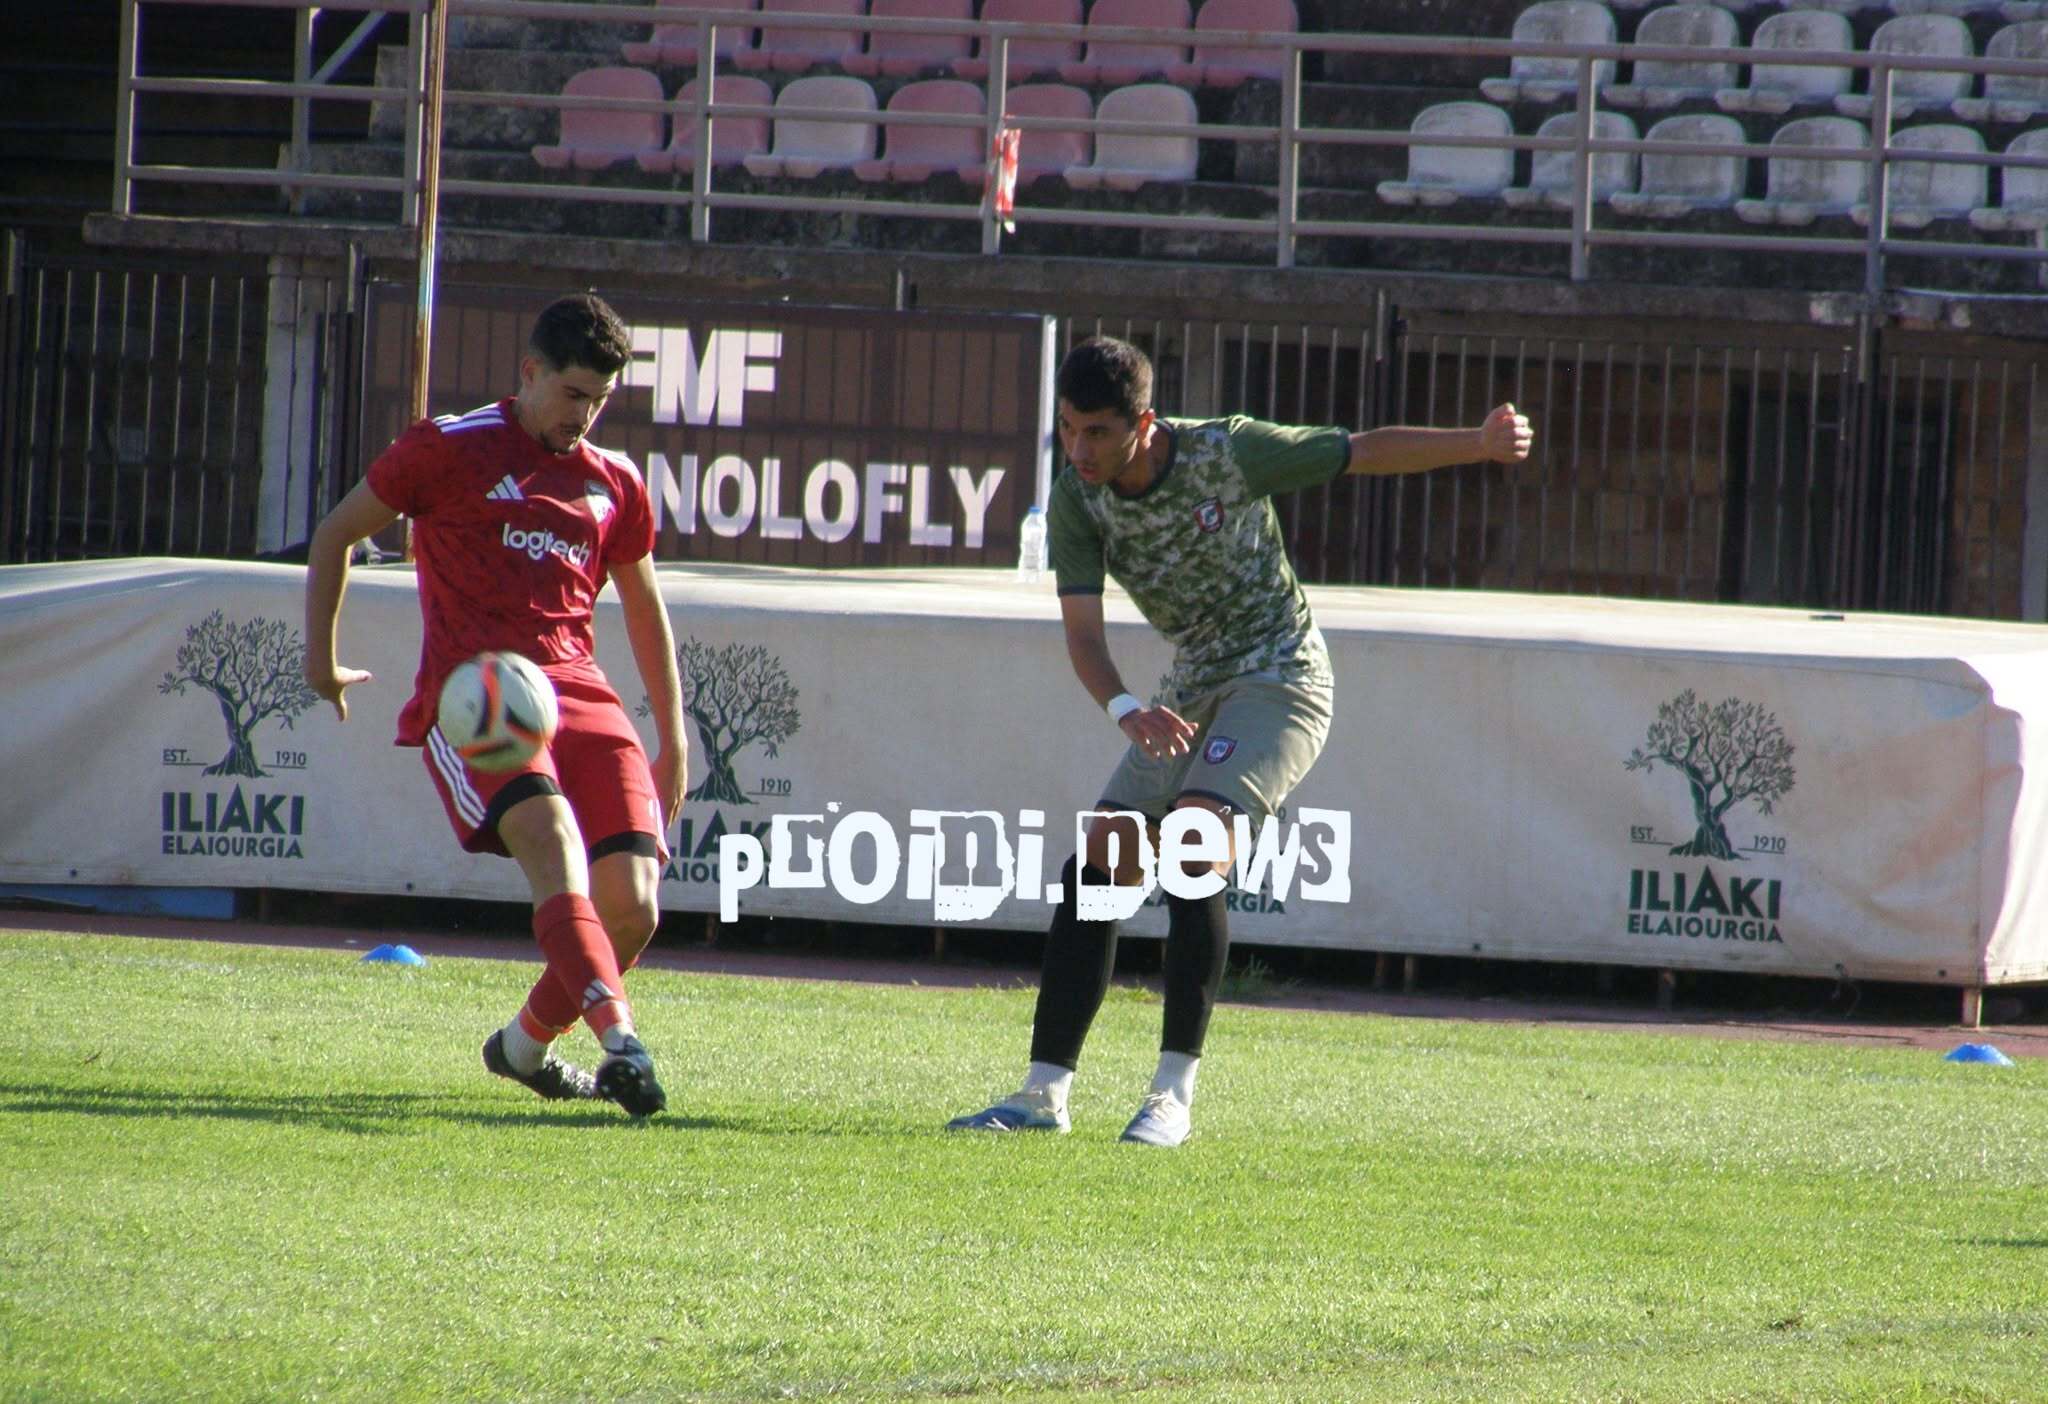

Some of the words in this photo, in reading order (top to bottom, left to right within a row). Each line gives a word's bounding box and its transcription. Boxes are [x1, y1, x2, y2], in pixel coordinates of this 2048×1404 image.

[606, 449, 1006, 549] NOLOFLY
[163, 749, 190, 763] EST.
[275, 751, 306, 766] 1910
[760, 778, 792, 793] 1910
[162, 783, 304, 835] ILIAKI
[162, 835, 304, 859] ELAIOURGIA
[1631, 825, 1656, 841] EST.
[1753, 835, 1786, 850] 1910
[1629, 865, 1782, 920] ILIAKI
[1628, 914, 1783, 943] ELAIOURGIA
